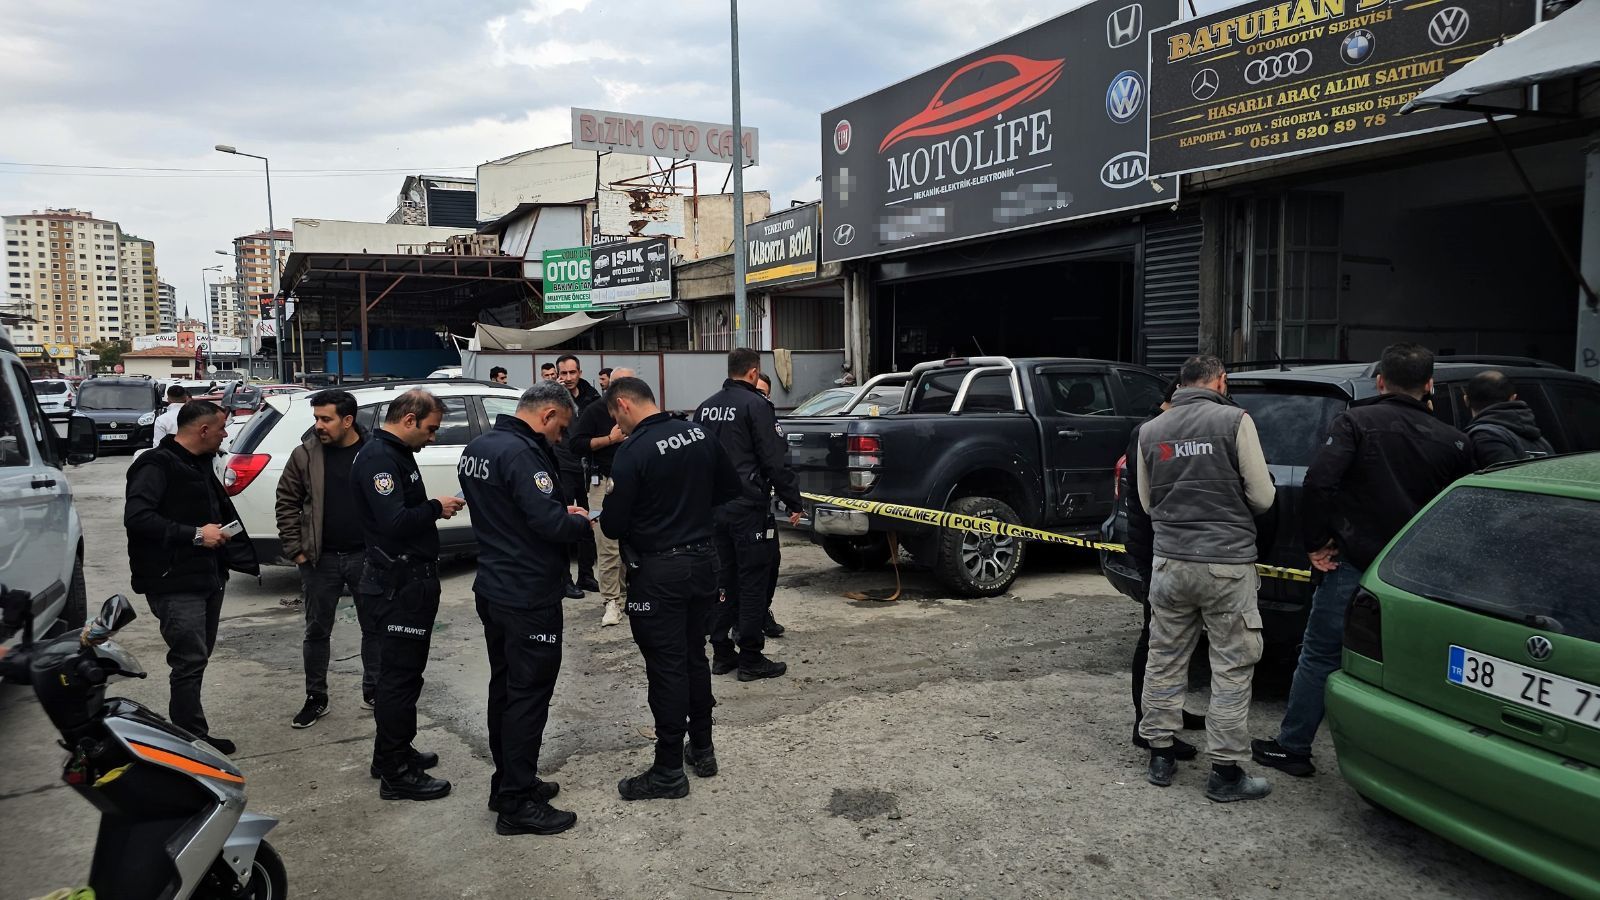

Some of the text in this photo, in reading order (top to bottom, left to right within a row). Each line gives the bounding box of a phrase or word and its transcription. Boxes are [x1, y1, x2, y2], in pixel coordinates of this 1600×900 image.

[1168, 0, 1346, 63] BATUHAN
[1246, 25, 1325, 55] OTOMOTİV
[1328, 6, 1392, 35] SERVİSİ
[1207, 58, 1445, 120] HASARLI ARAÇ ALIM SATIMI
[651, 121, 700, 153] OTO
[1179, 130, 1227, 147] KAPORTA
[1234, 123, 1262, 136] BOYA
[1270, 110, 1321, 129] SİGORTA
[1331, 100, 1375, 117] KASKO
[1250, 114, 1387, 148] 0531 820 89 78
[886, 108, 1053, 193] MOTOLİFE
[1108, 158, 1144, 182] KIA
[749, 225, 813, 267] KABORTA BOYA
[764, 218, 795, 236] YENER OTO
[546, 259, 591, 281] OTOG
[611, 247, 645, 267] IŞIK
[1174, 441, 1213, 458] kilim
[1452, 665, 1463, 675] TR
[1466, 657, 1495, 688] 38
[1520, 672, 1553, 707] ZE
